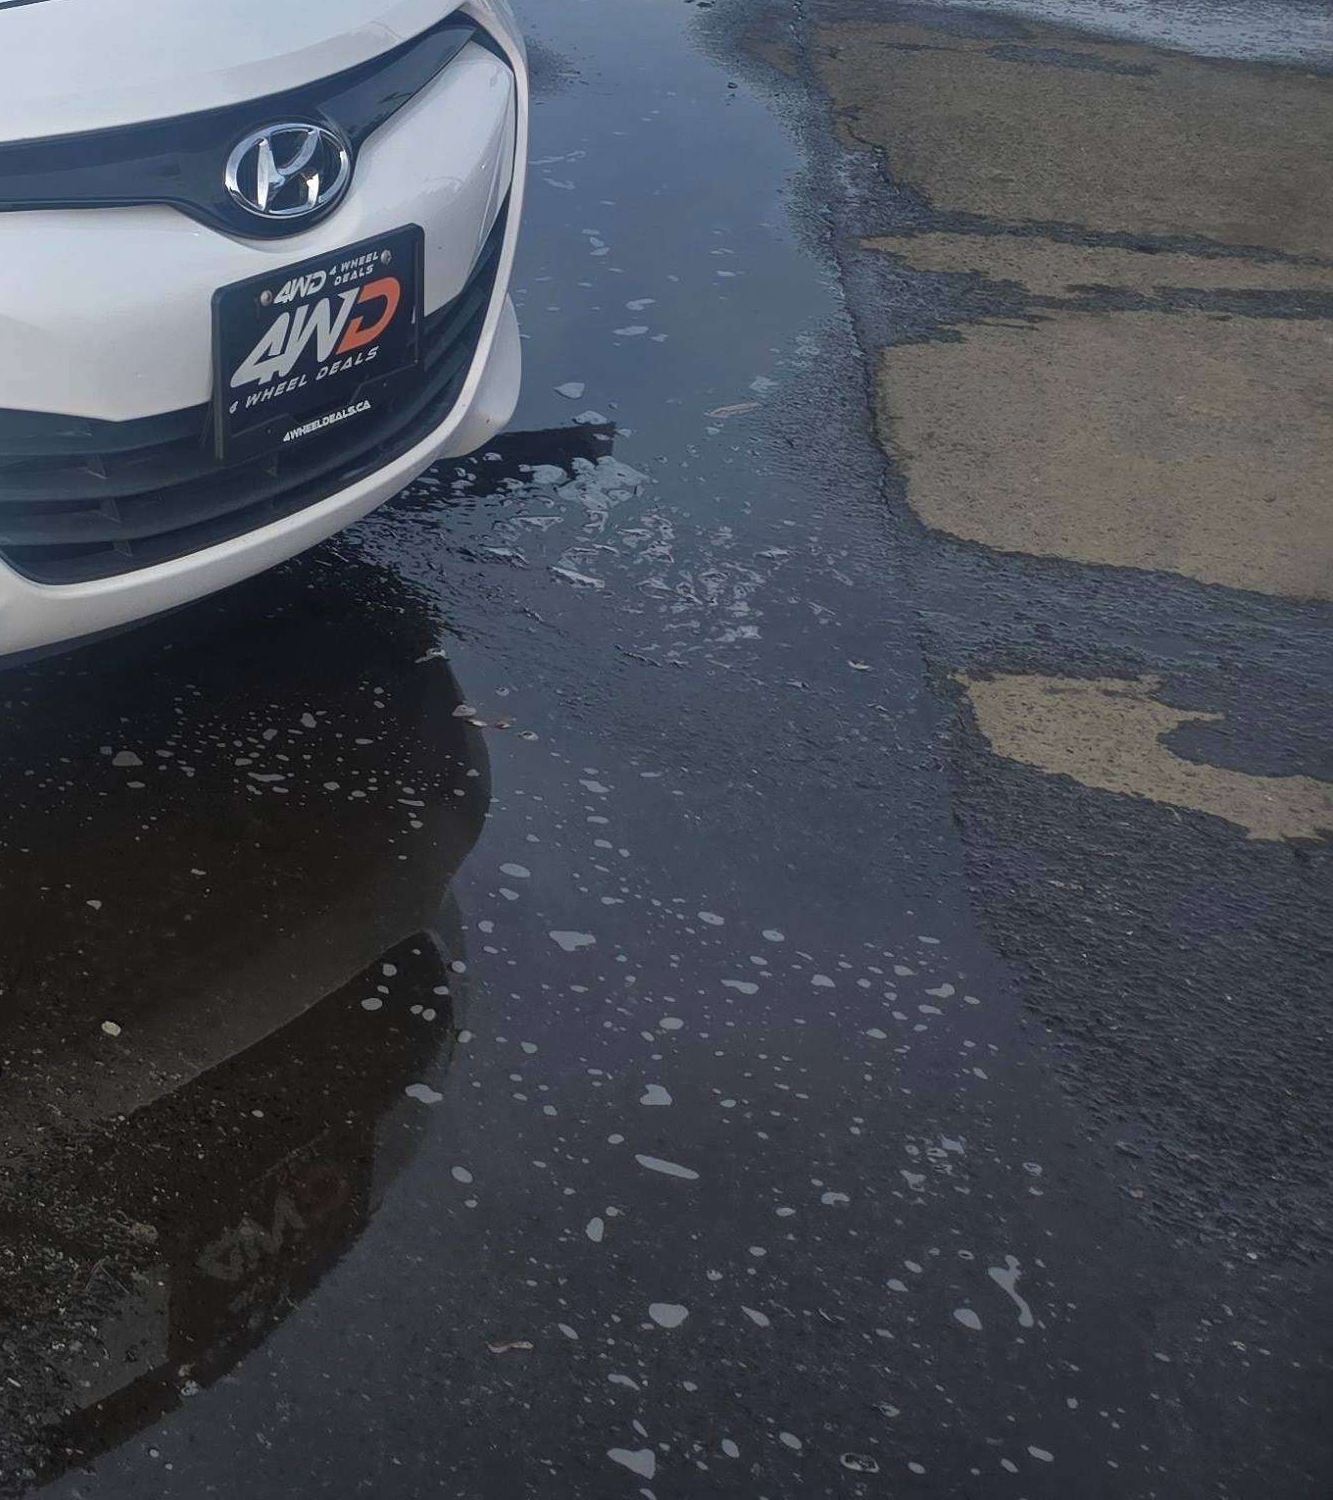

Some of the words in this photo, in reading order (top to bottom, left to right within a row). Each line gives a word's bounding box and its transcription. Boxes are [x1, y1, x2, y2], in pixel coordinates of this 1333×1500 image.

[329, 265, 337, 276] 4
[340, 251, 379, 272] WHEEL
[334, 263, 374, 287] DEALS
[273, 269, 327, 304] 4WD
[229, 277, 401, 388] 4WD
[245, 373, 308, 409] WHEEL
[315, 345, 380, 381] DEALS
